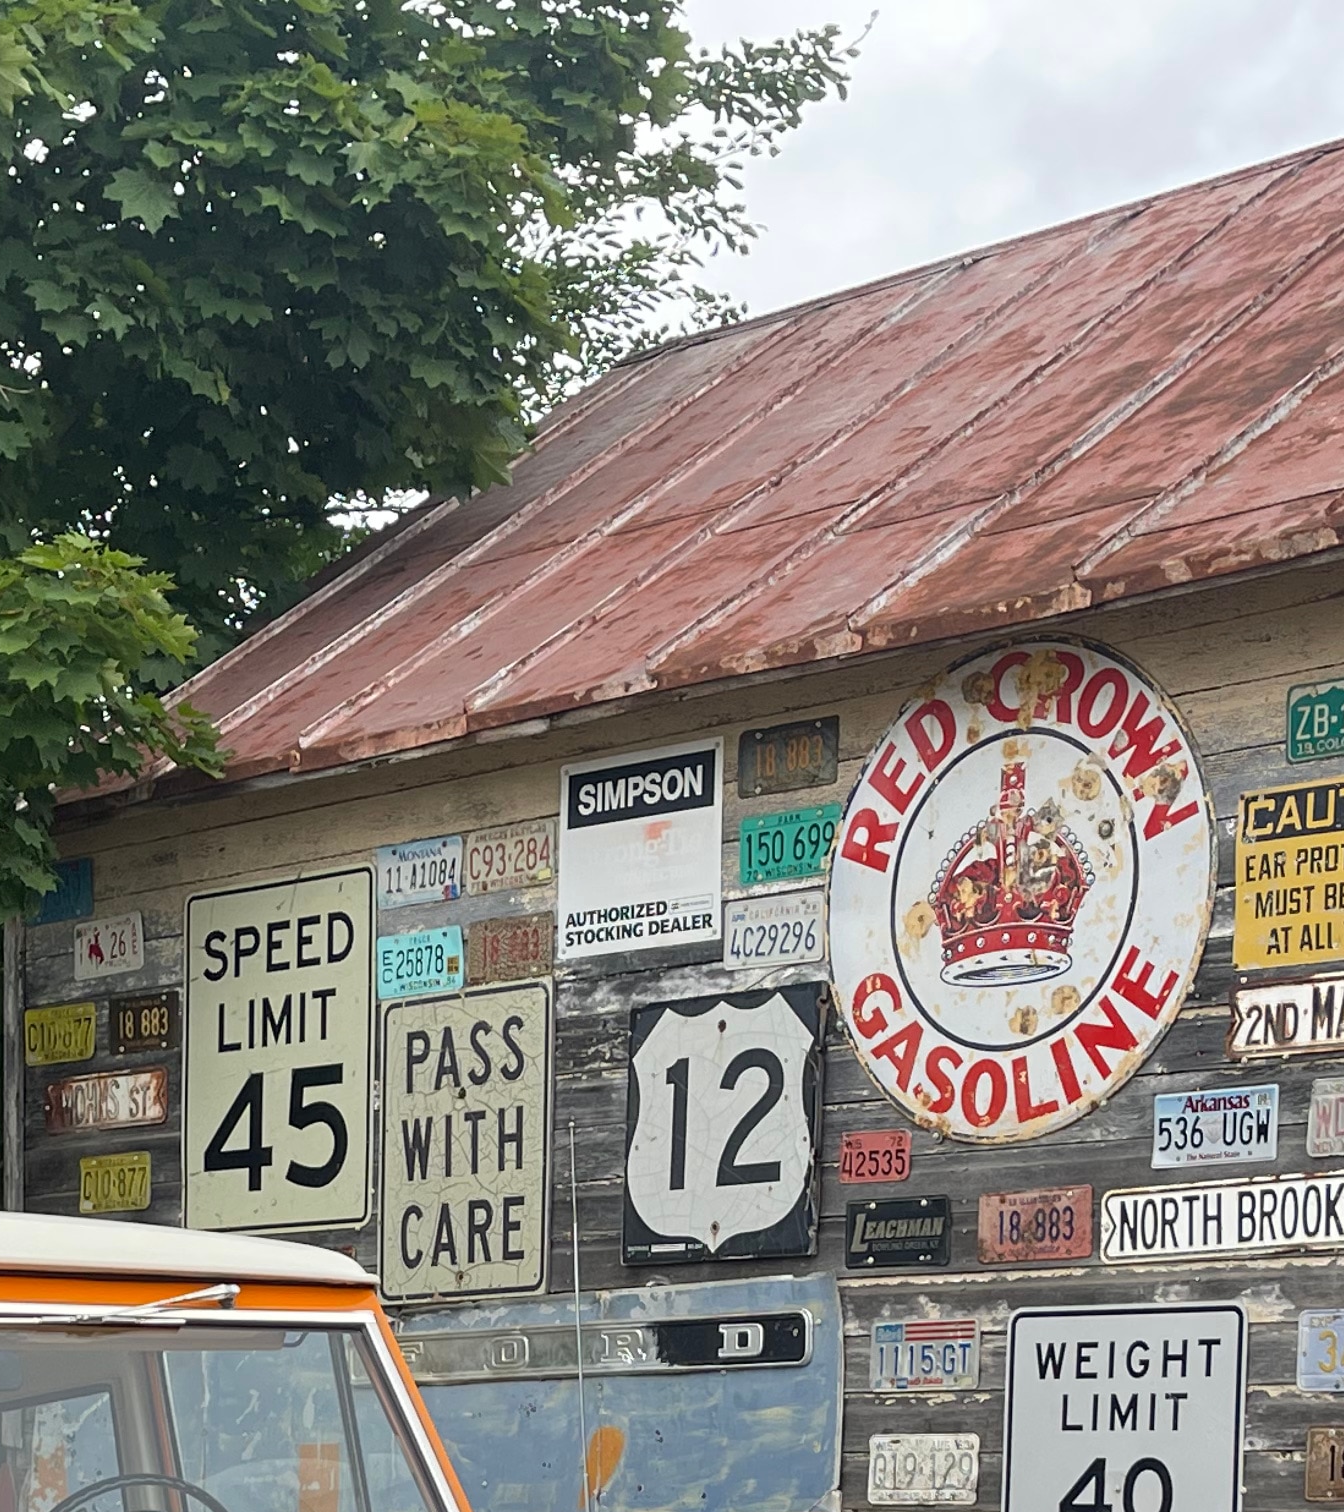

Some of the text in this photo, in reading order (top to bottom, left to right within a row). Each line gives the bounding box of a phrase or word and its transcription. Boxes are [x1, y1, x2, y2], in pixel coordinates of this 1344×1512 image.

[987, 651, 1200, 841] CROWN
[577, 764, 704, 816] SIMPSON
[841, 698, 958, 873] RED
[398, 847, 443, 862] MONTANA
[746, 821, 836, 869] 150 699
[1244, 853, 1286, 882] EAR
[565, 901, 668, 929] AUTHORIZED
[1255, 889, 1313, 919] MUST
[110, 930, 127, 960] 26
[203, 910, 355, 983] SPEED
[565, 913, 713, 947] STOCKING DEALER
[731, 918, 816, 959] 4C29296
[1266, 929, 1293, 955] AT
[1300, 926, 1336, 952] ALL
[396, 944, 445, 979] 25878
[119, 1006, 169, 1038] 18 883
[218, 987, 338, 1053] LIMIT
[851, 945, 1180, 1128] GASOLINE
[1245, 1001, 1298, 1045] 2ND
[406, 1014, 526, 1095] PASS
[129, 1085, 150, 1118] ST
[665, 1047, 785, 1190] 12
[1182, 1094, 1250, 1114] Arkansas
[203, 1062, 350, 1193] 45
[401, 1106, 525, 1183] WITH
[889, 1136, 903, 1147] 72
[1158, 1109, 1270, 1151] 536 UGW
[841, 1149, 906, 1178] 42535
[400, 1195, 526, 1270] CARE
[850, 1213, 945, 1253] LEACHMAN
[998, 1205, 1074, 1245] 18 883
[1117, 1194, 1223, 1251] NORTH
[400, 1322, 765, 1370] FORD
[1035, 1338, 1222, 1379] WEIGHT
[1061, 1392, 1188, 1431] LIMIT
